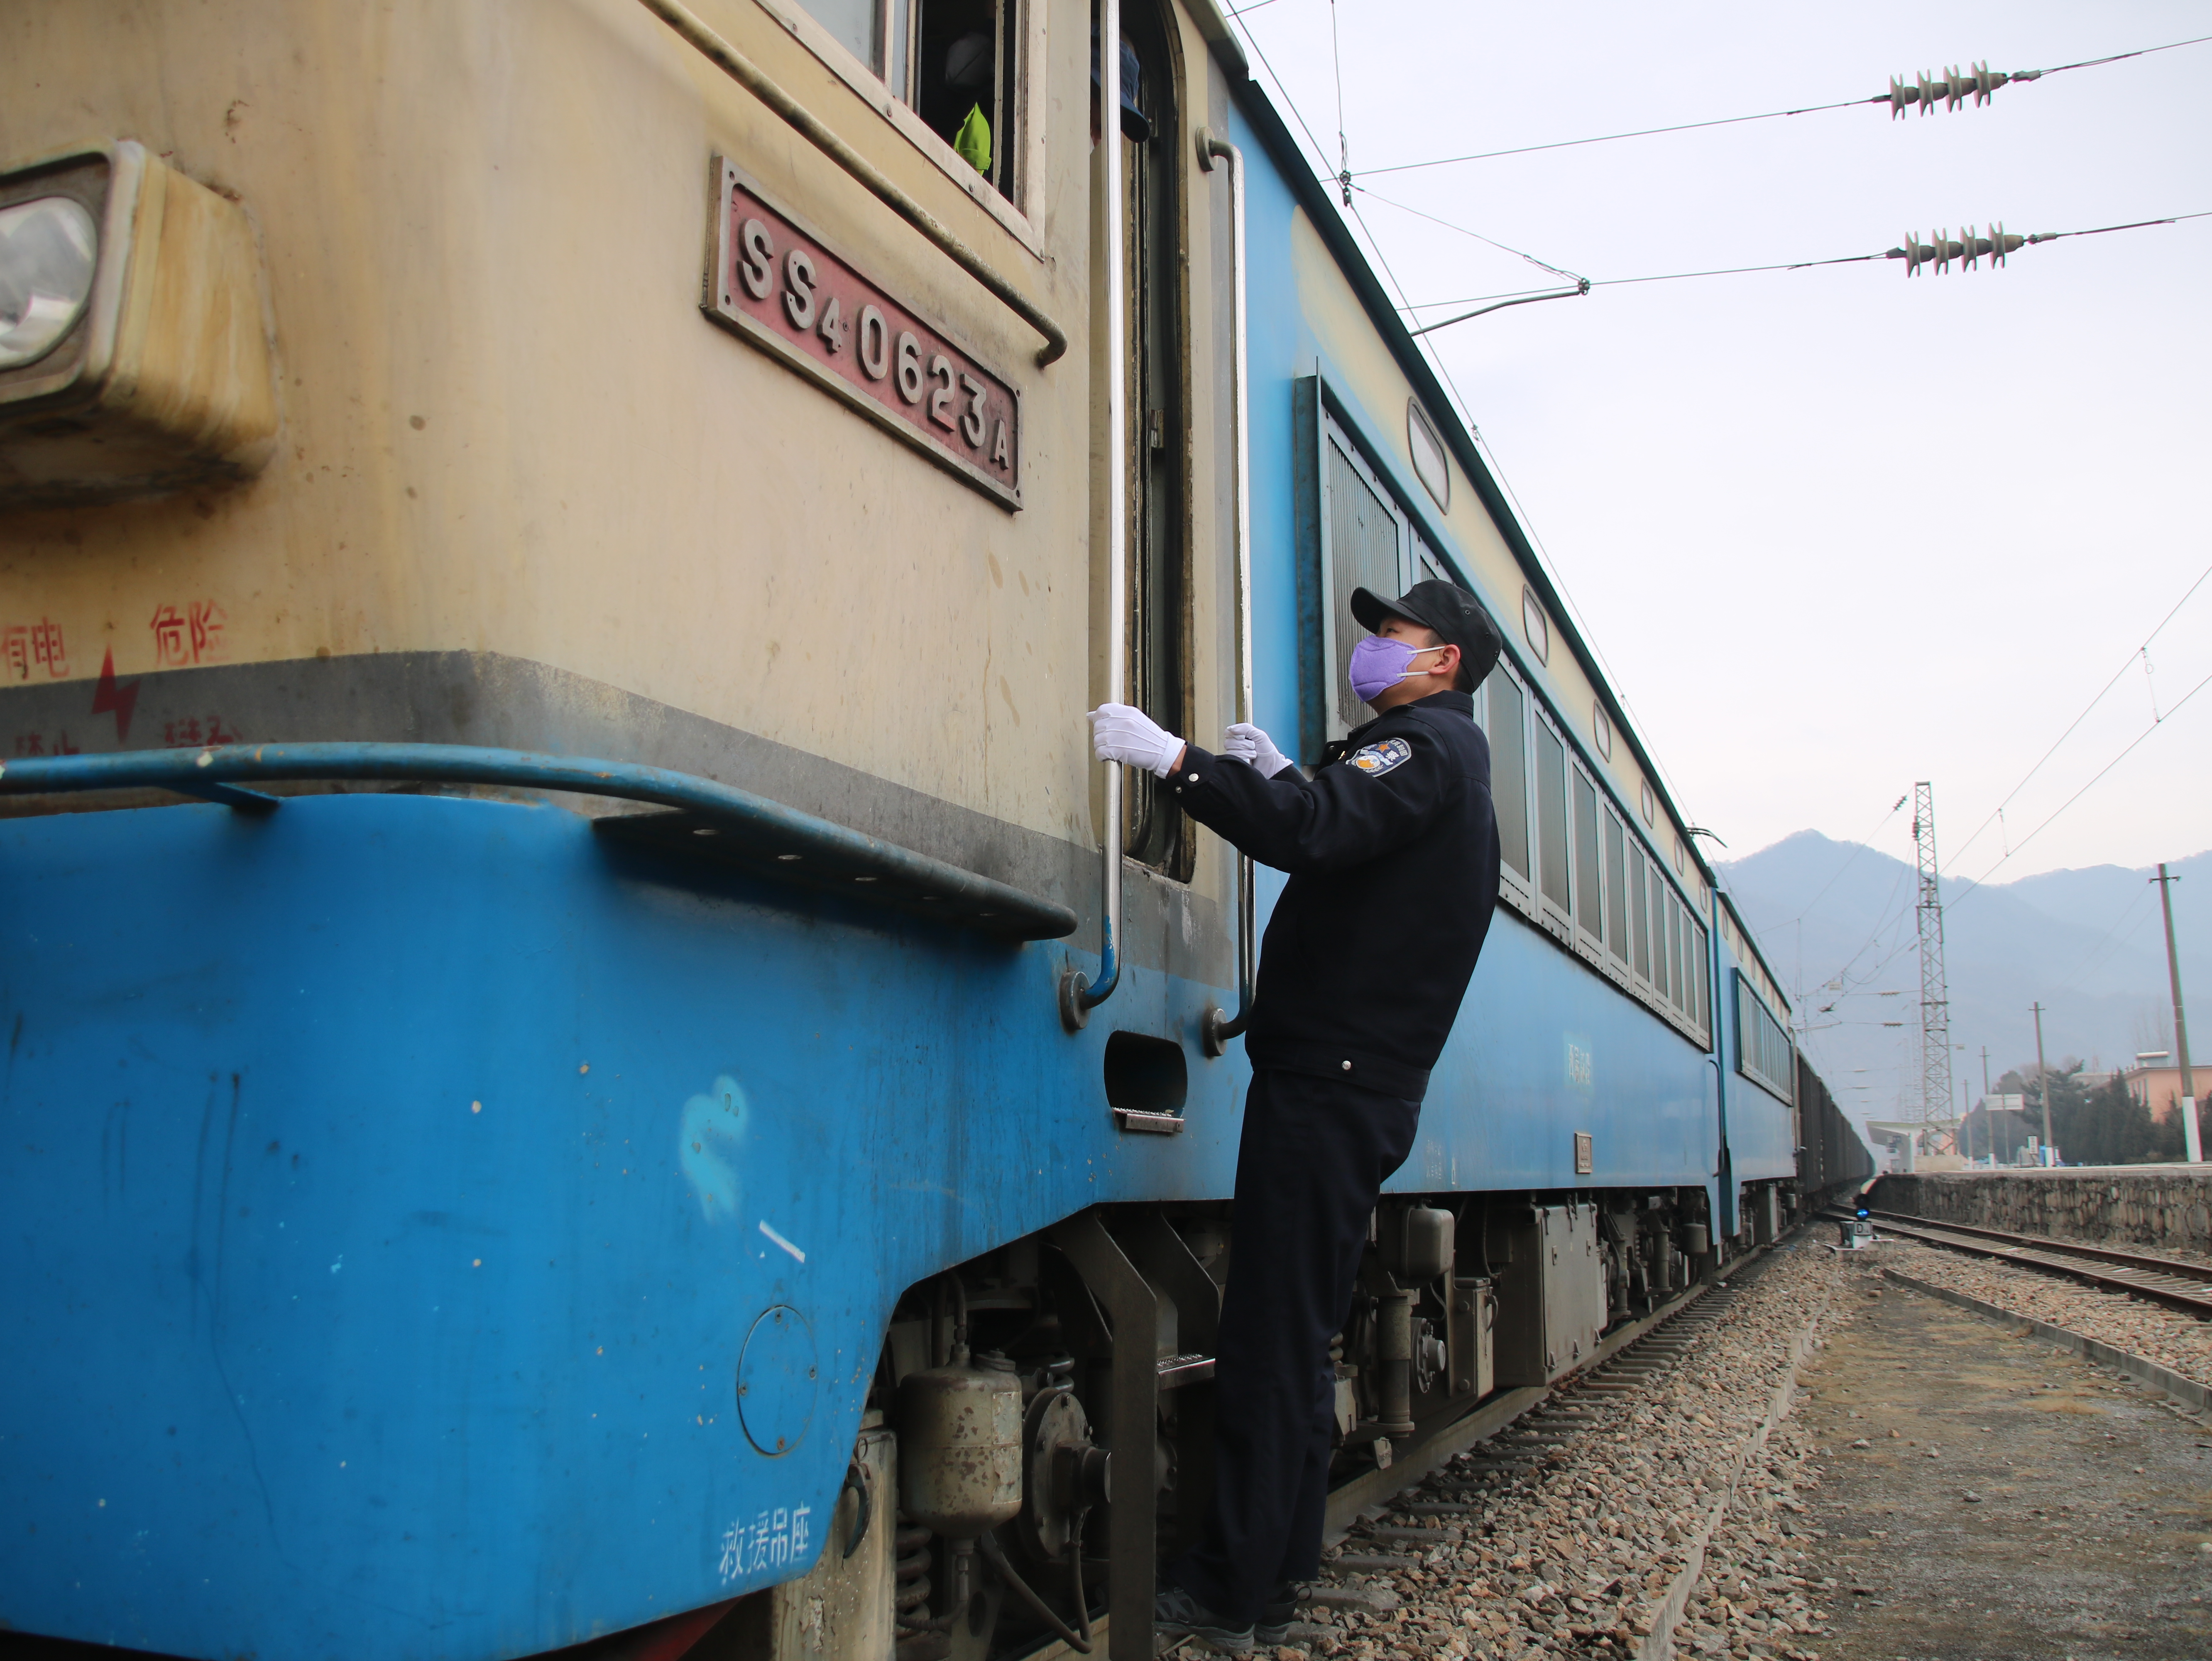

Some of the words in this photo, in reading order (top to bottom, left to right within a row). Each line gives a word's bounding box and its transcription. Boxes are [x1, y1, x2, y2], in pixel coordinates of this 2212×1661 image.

[0, 616, 71, 681] 有电
[150, 598, 231, 667] 危险
[1369, 751, 1384, 759] POLICE
[719, 1500, 811, 1580] 救援吊座
